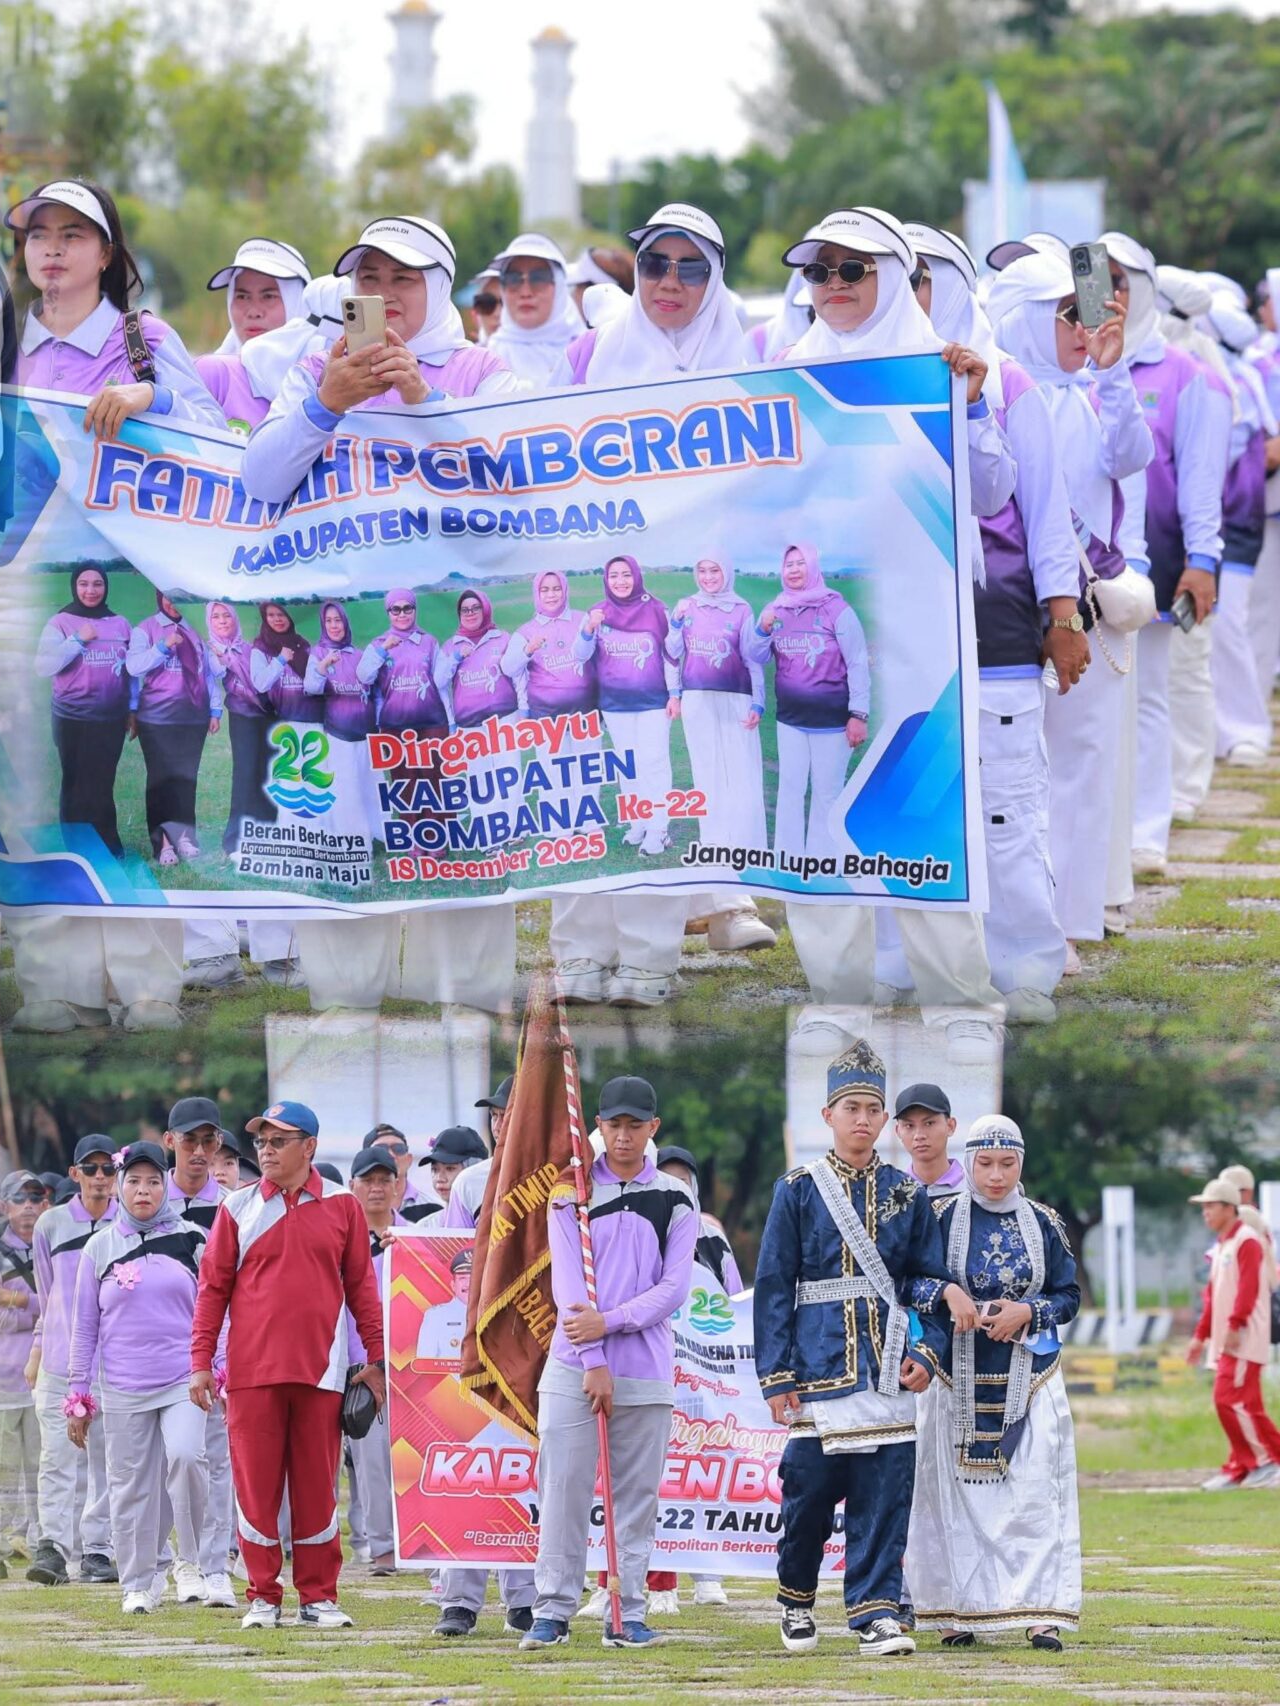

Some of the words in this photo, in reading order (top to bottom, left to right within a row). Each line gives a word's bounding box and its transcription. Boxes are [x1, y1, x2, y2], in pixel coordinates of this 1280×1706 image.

[370, 400, 795, 491] PEMBERANI
[231, 507, 429, 572] KABUPATEN
[441, 499, 646, 536] BOMBANA
[271, 723, 335, 789] 22
[368, 709, 603, 777] Dirgahayu
[377, 749, 637, 813] KABUPATEN
[243, 821, 296, 842] Berani
[298, 826, 365, 851] Berkarya
[384, 794, 607, 851] BOMBANA
[617, 789, 708, 823] Ke-22
[239, 857, 324, 880] Bombana
[328, 866, 370, 886] Maju
[314, 850, 369, 863] Berkembang
[389, 856, 416, 881] 18
[421, 848, 531, 880] Desember
[537, 834, 607, 867] 2025
[682, 844, 775, 872] Jangan
[780, 850, 836, 881] Lupa
[842, 854, 950, 886] Bahagia
[502, 1161, 560, 1221] TIMUR
[690, 1286, 735, 1319] 22
[668, 1412, 788, 1459] irgahayu
[704, 1509, 783, 1533] TAHU
[721, 1540, 778, 1556] Berkem
